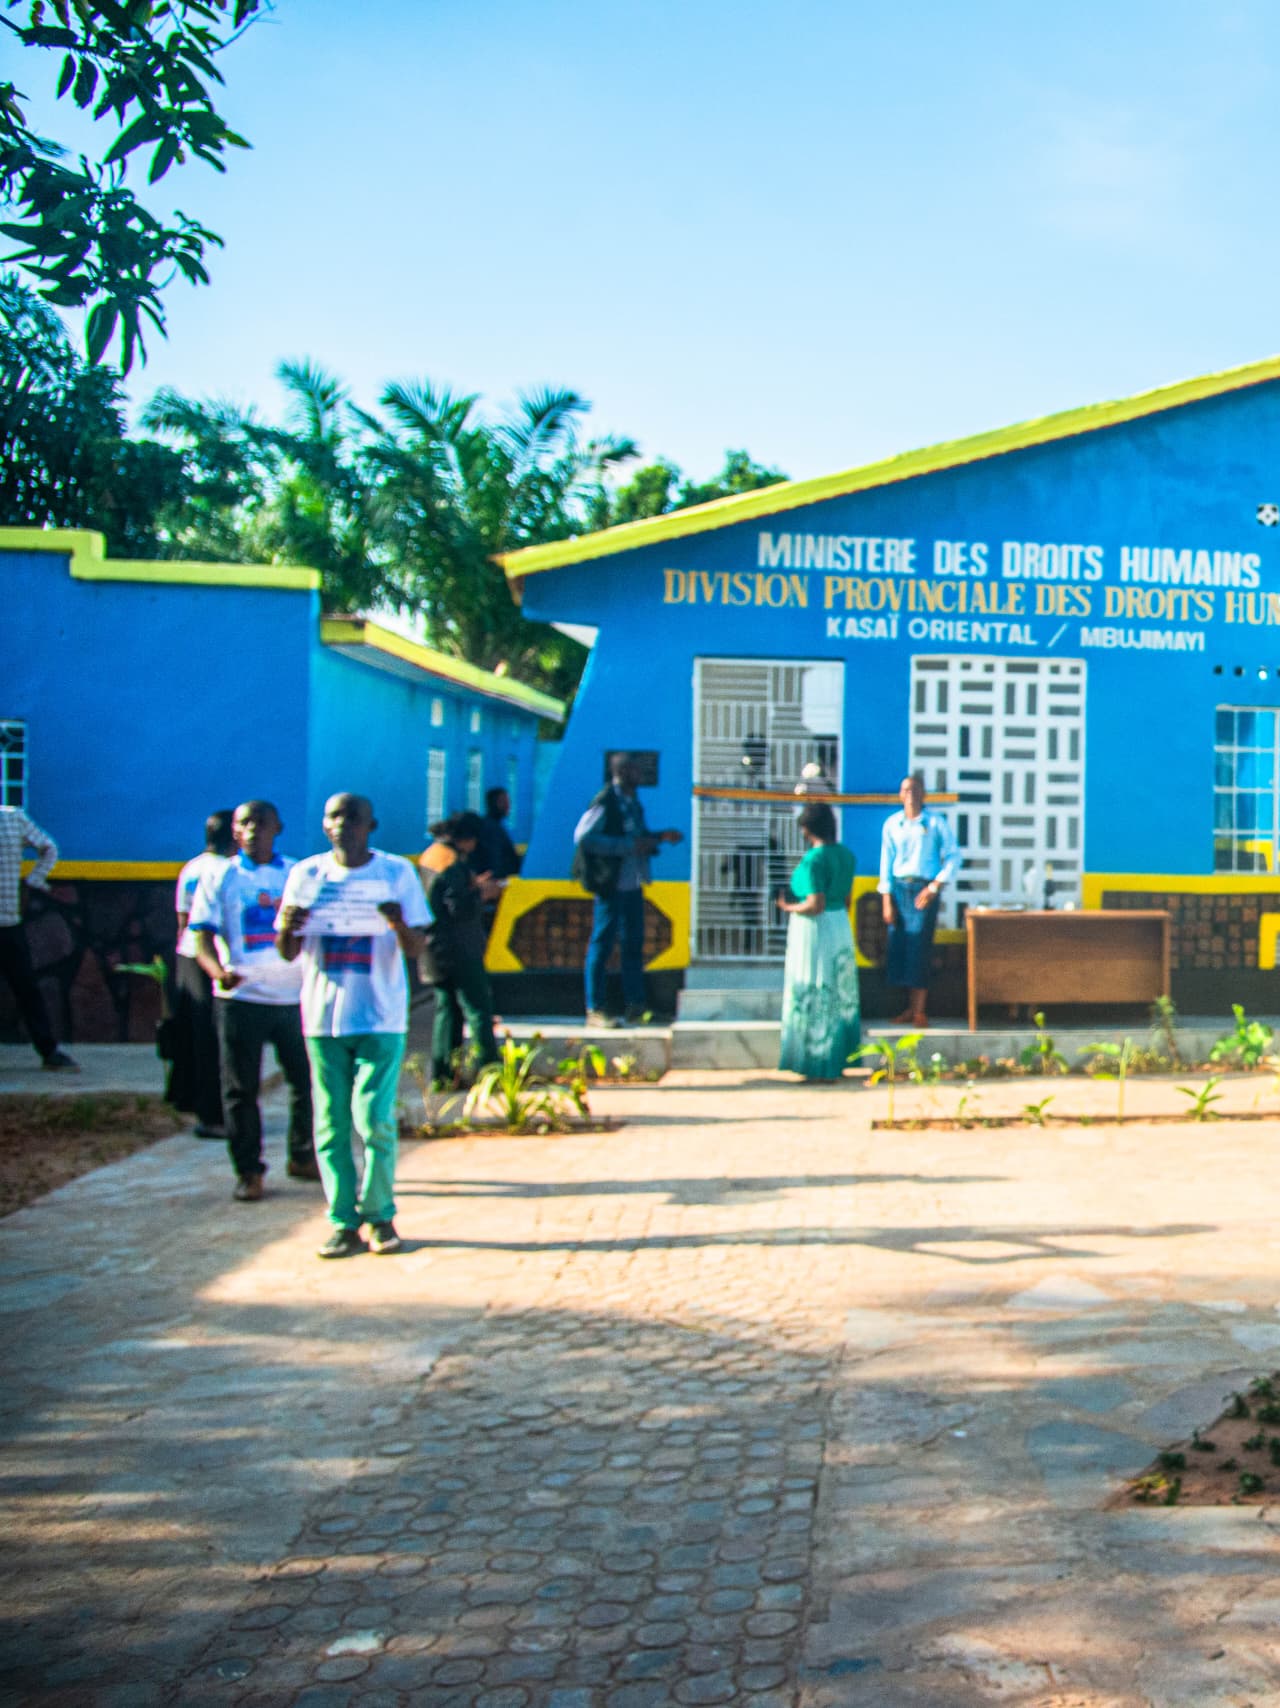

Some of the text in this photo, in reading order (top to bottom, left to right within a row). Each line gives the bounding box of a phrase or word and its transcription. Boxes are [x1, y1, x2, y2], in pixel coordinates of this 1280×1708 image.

[758, 532, 1261, 588] MINISTERE DES DROITS HUMAINS
[663, 568, 808, 608] DIVISION
[824, 575, 1026, 615] PROVINCIALE
[1035, 583, 1092, 617] DES
[1104, 586, 1214, 622] DROITS
[826, 613, 1205, 651] KASAÏ ORIENTAL / MBUJIMAYI
